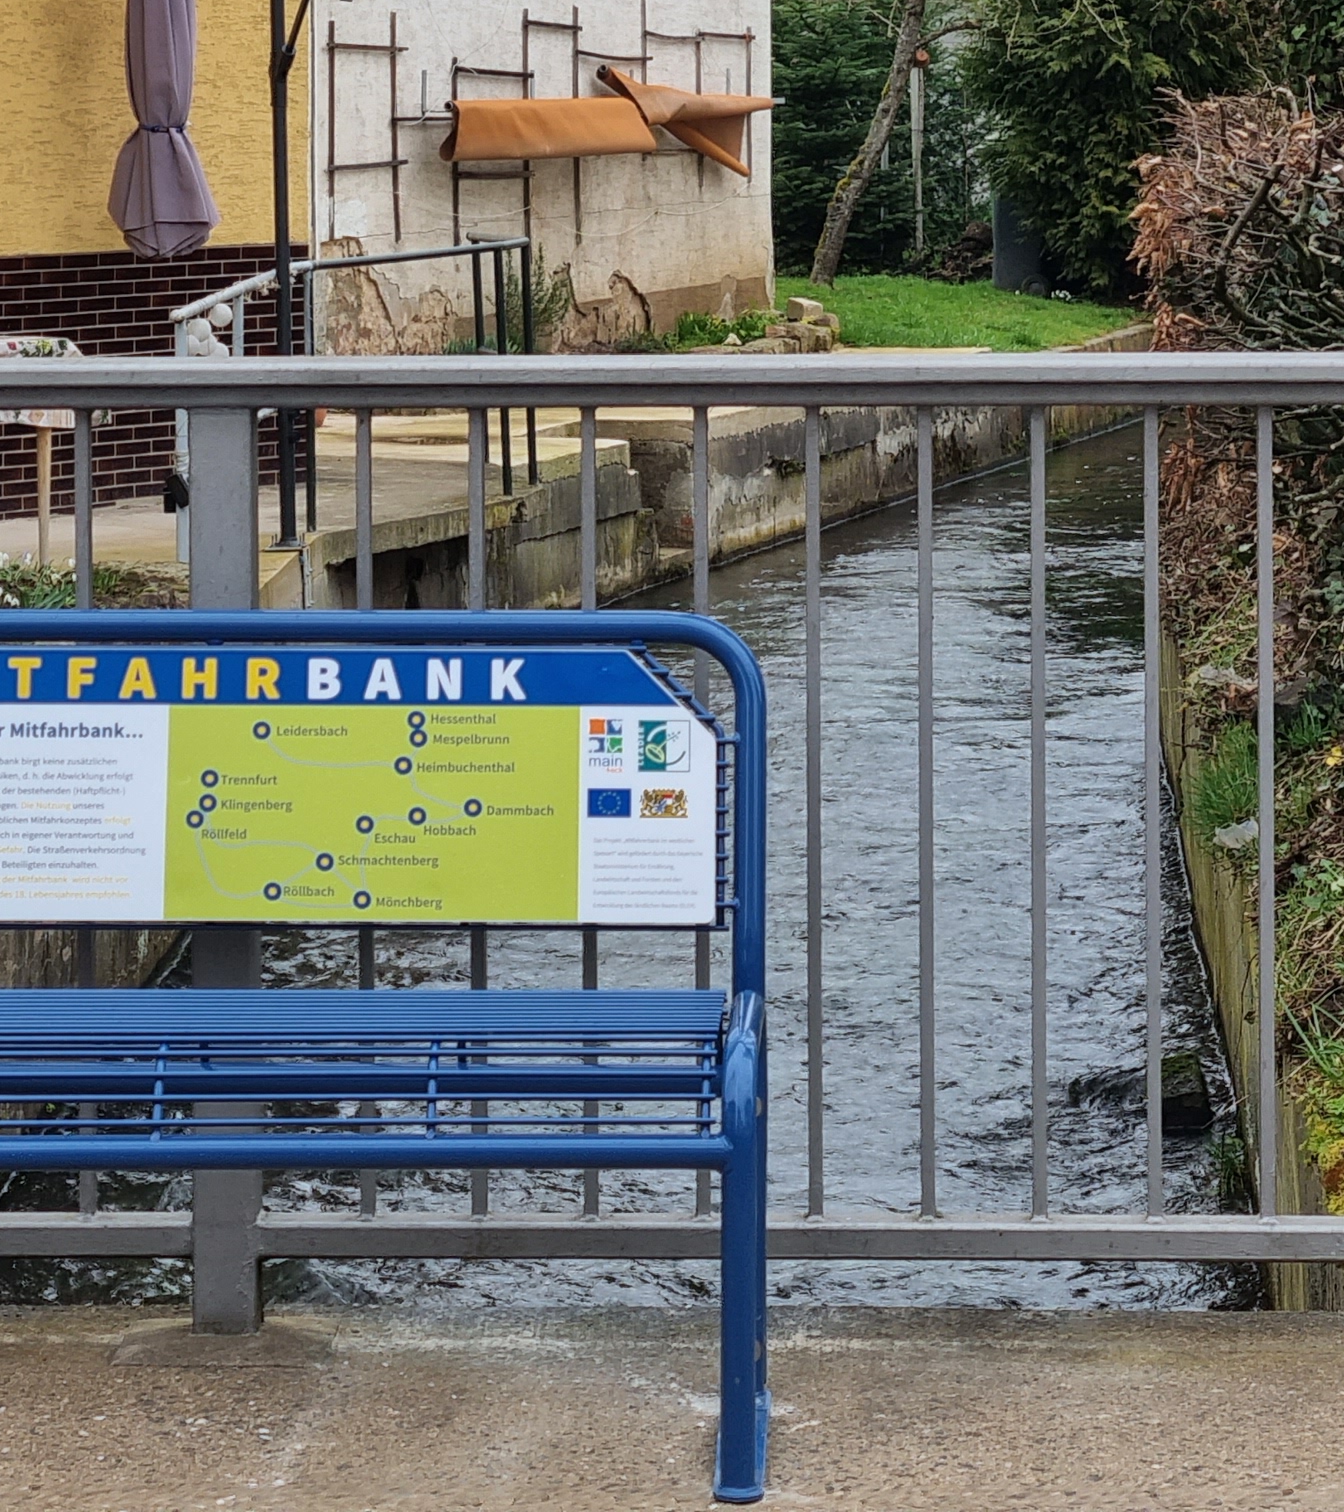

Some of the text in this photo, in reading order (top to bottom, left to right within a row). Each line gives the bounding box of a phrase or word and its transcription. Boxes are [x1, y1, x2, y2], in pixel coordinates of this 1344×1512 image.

[430, 714, 496, 725] Hessenthal
[10, 722, 142, 738] Mitfahrbank...
[276, 725, 348, 737] Leidersbach
[432, 734, 510, 747] Mespelbrunn
[21, 757, 40, 767] birgt
[43, 757, 65, 765] keine
[67, 757, 118, 765] zusätzlichen
[588, 755, 623, 767] main
[416, 762, 515, 773] Heimbuchenthal
[23, 772, 30, 780] d.
[33, 772, 39, 780] h.
[42, 772, 55, 780] die
[56, 772, 104, 782] Abwicklung
[106, 772, 133, 782] erfolgt
[221, 774, 278, 785] Trennfurt
[2, 787, 16, 795] der
[17, 787, 71, 795] bestehenden
[73, 787, 126, 797] (Haftpflicht-)
[221, 800, 293, 813] Klingenberg
[486, 805, 554, 816] Dammbach
[31, 816, 102, 826] Mitfahrkonzeptes
[12, 831, 20, 839] in
[22, 831, 52, 841] eigener
[54, 831, 116, 841] Verantwortung
[118, 831, 134, 839] und
[201, 829, 247, 840] Röllfeld
[423, 825, 477, 836] Hobbach
[374, 833, 416, 844] Eschau
[27, 846, 40, 854] Die
[42, 846, 146, 856] Straßenverkehrsordnung
[2, 861, 46, 871] Beteiligten
[48, 861, 98, 869] einzuhalten.
[338, 855, 439, 869] Schmachtenberg
[283, 886, 335, 897] Röllbach
[375, 896, 443, 911] Mönchberg
